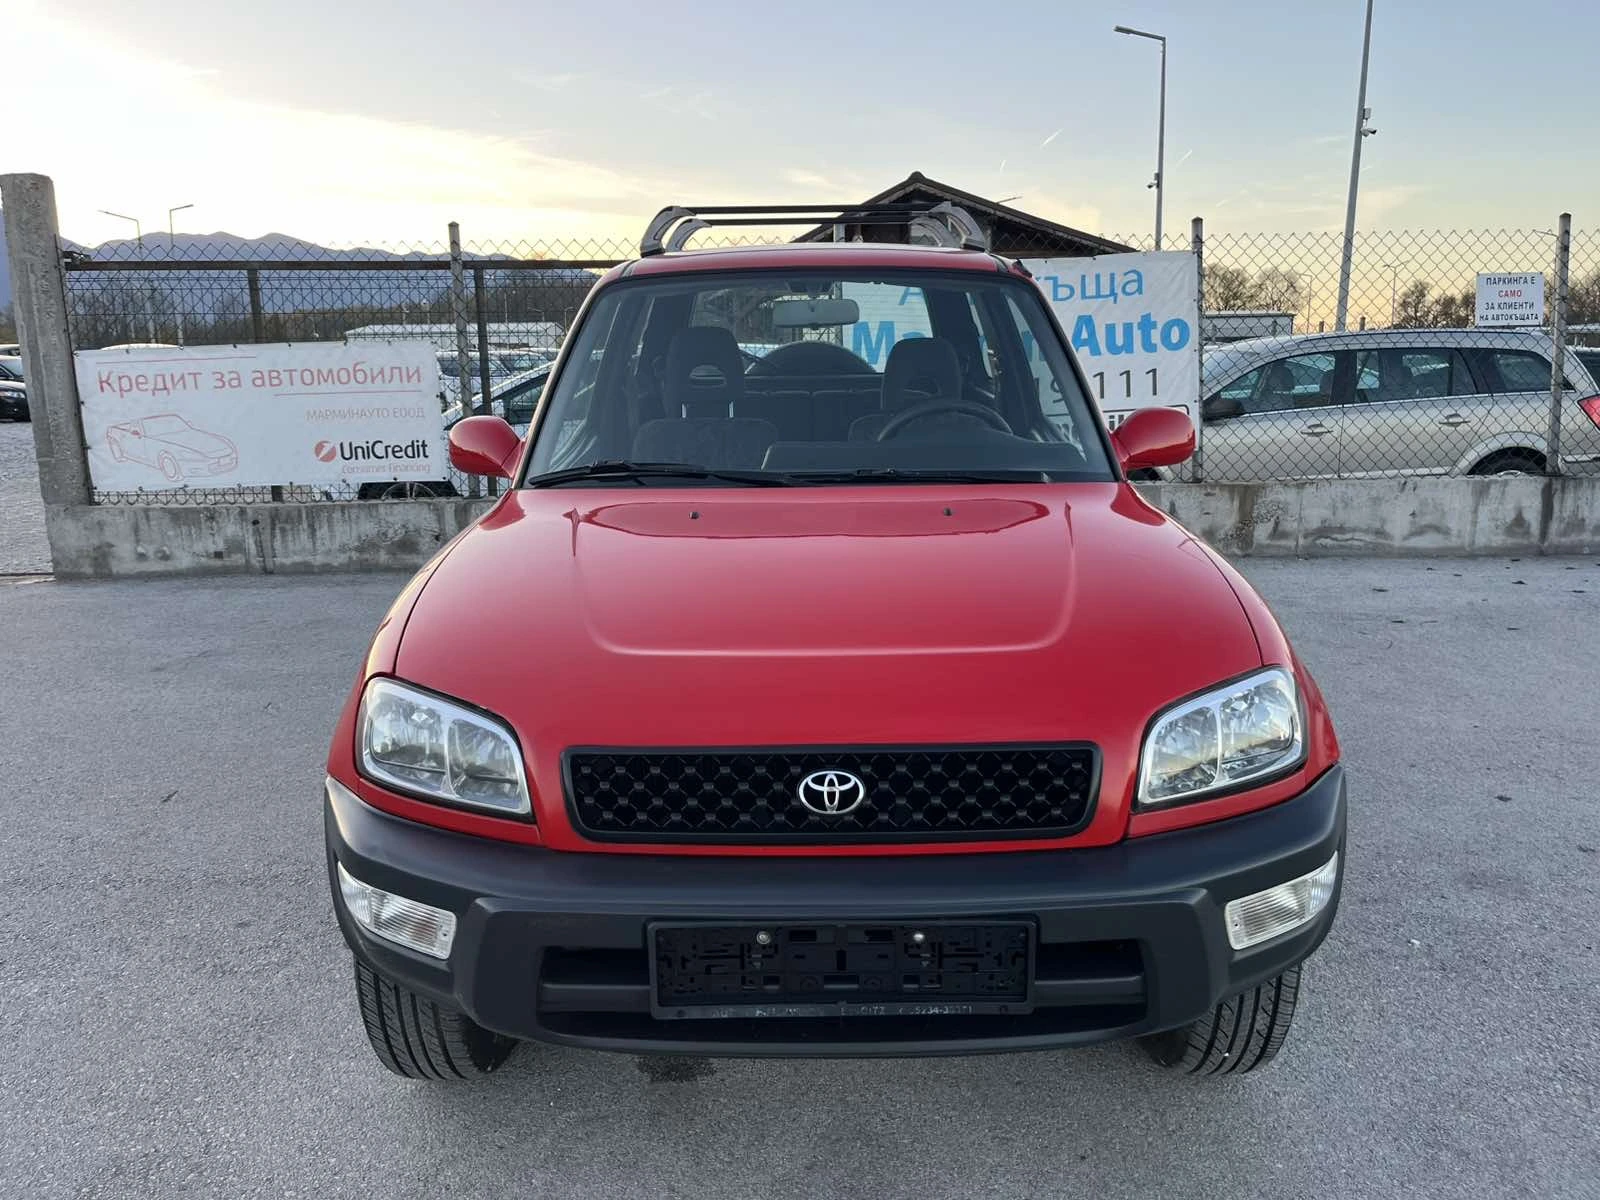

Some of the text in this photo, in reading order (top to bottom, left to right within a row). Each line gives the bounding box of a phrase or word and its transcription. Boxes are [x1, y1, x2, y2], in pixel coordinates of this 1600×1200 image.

[1486, 276, 1528, 286] ПАРКИНГА
[1498, 289, 1522, 298] САМО
[1485, 301, 1535, 311] ЗА КЛИЕНТИ
[1072, 312, 1190, 356] Auto
[98, 361, 422, 398] Кредит за автомобили
[339, 439, 429, 461] UniCredit
